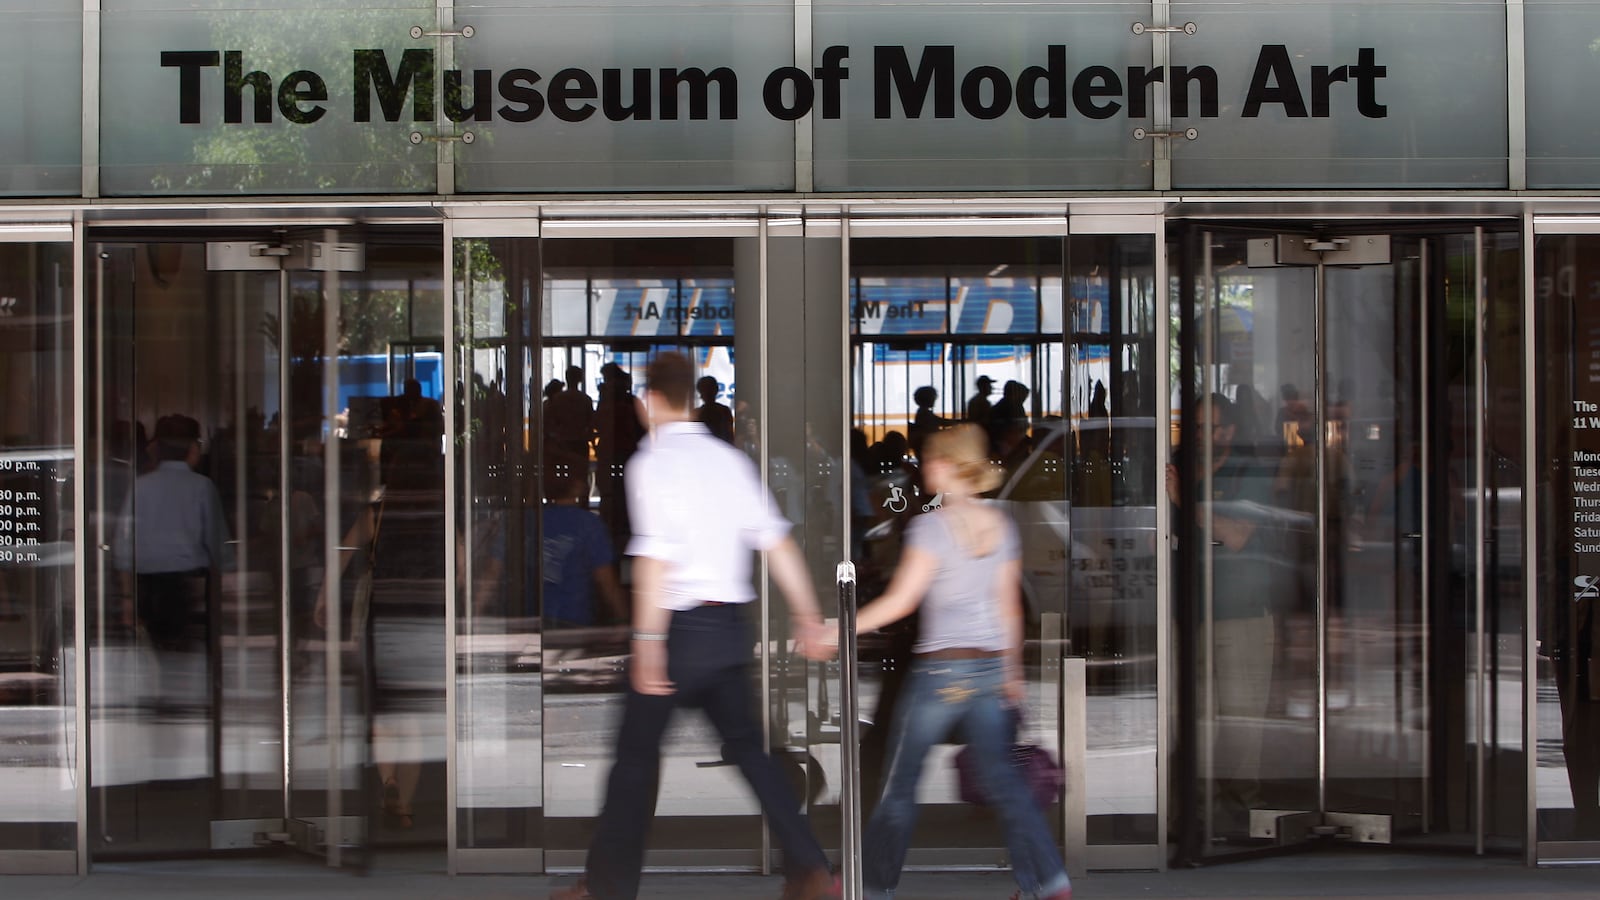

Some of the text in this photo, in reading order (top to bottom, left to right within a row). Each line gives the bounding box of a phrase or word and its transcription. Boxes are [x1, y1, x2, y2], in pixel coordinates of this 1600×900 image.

[161, 44, 1388, 124] The Museum of Modern Art
[1573, 401, 1598, 412] The
[1573, 417, 1587, 429] 11
[15, 462, 40, 473] p.m.
[15, 492, 40, 503] p.m.
[1573, 496, 1600, 507] Thur
[15, 507, 40, 518] p.m.
[15, 522, 40, 533] p.m.
[1574, 527, 1600, 538] Satu
[15, 537, 40, 548] p.m.
[15, 553, 40, 564] p.m.
